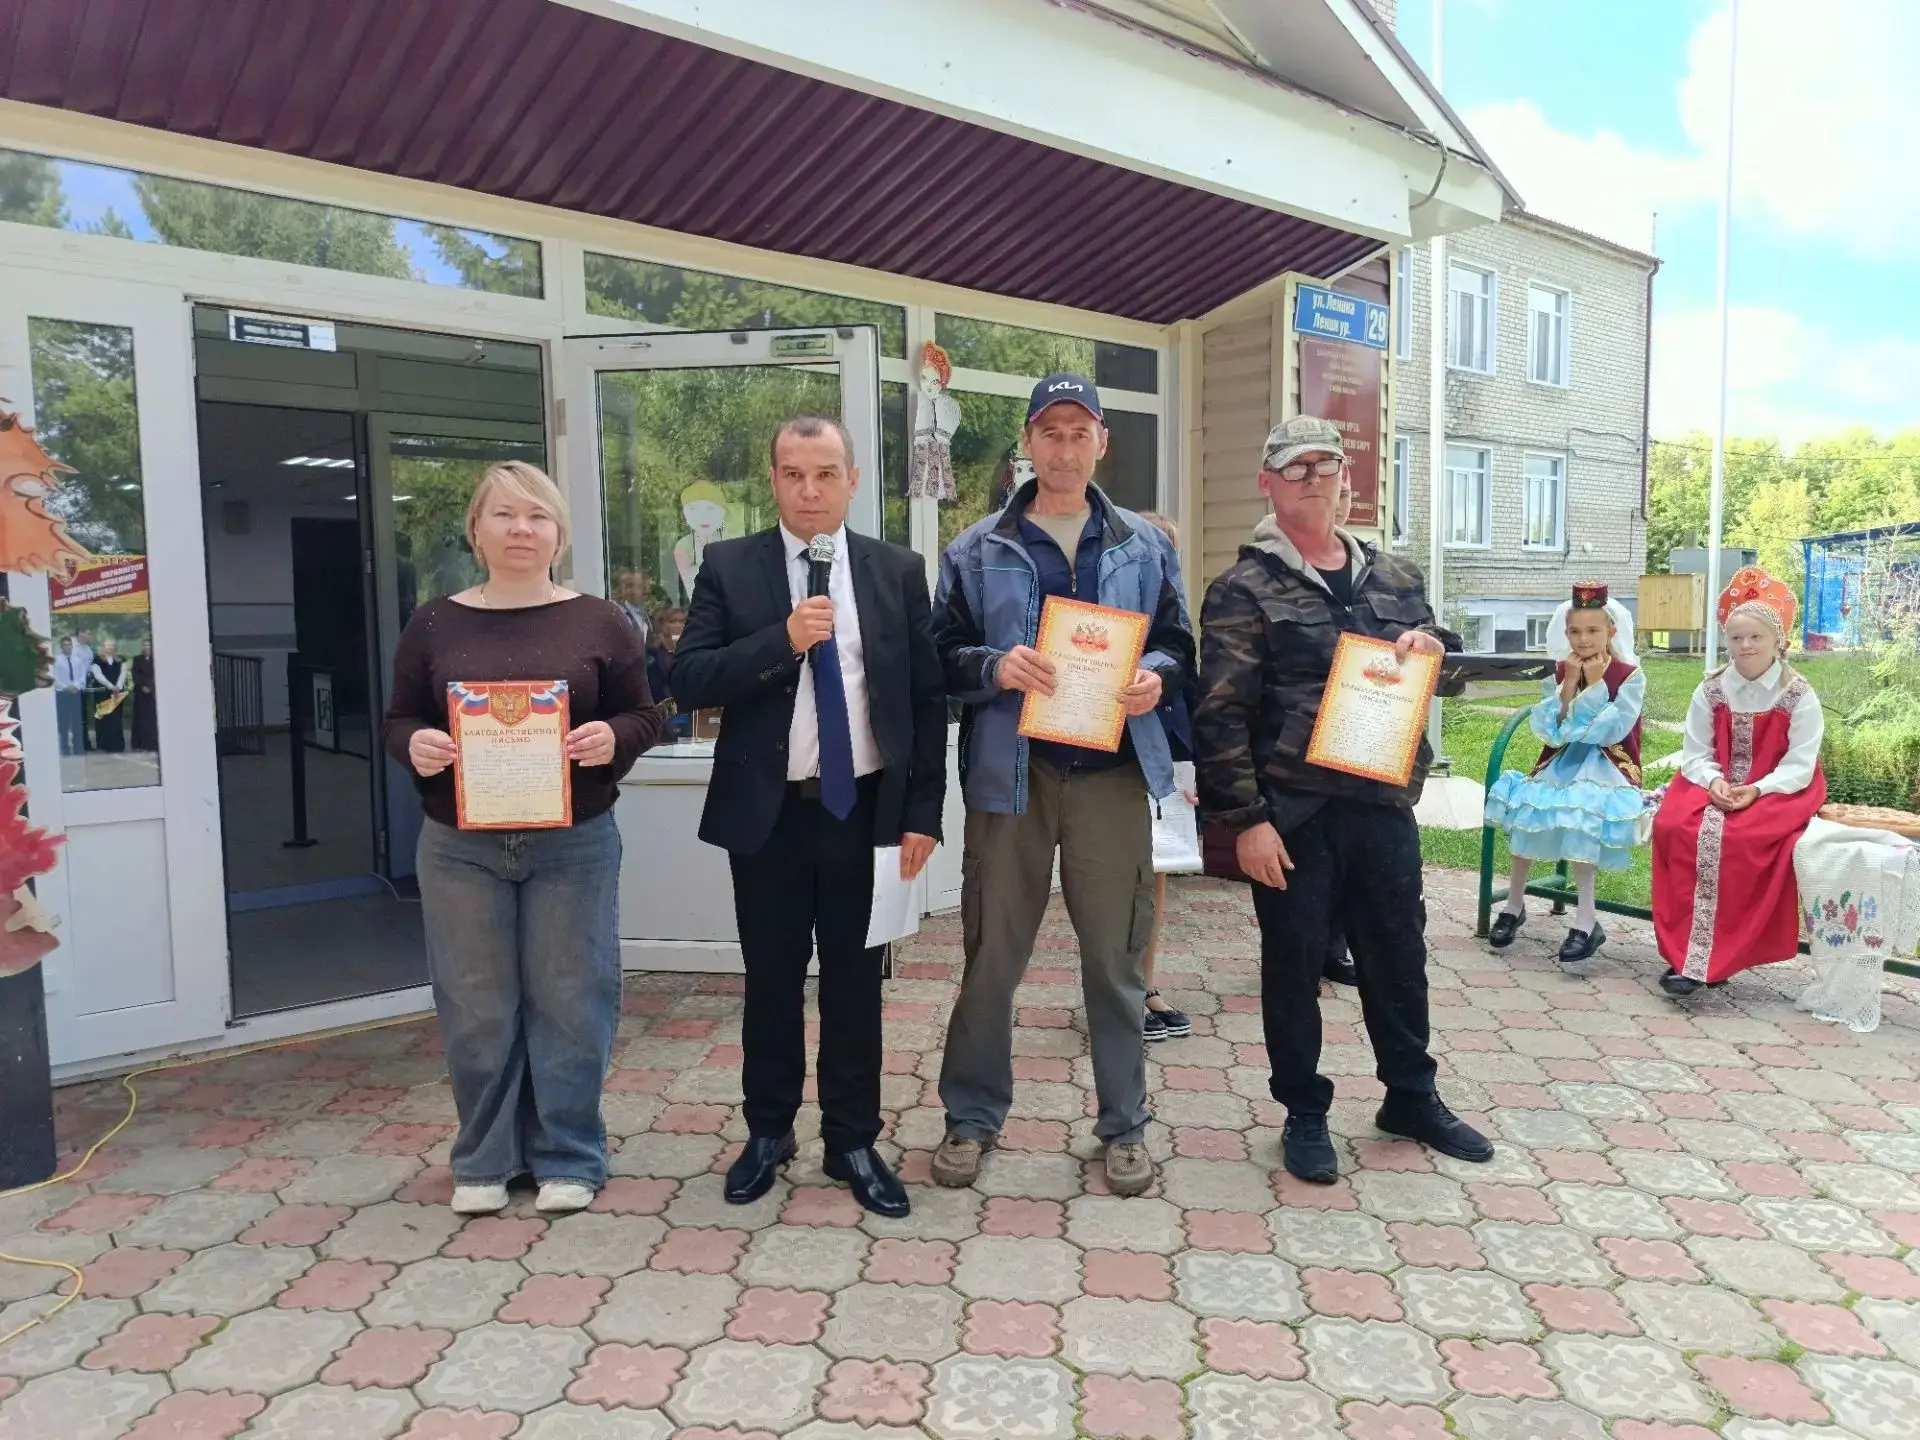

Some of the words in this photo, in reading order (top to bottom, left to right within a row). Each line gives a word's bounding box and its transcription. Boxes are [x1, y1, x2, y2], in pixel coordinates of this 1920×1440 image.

[1312, 293, 1325, 309] ул.
[1326, 294, 1356, 316] Ленина
[1312, 312, 1339, 332] Ленин
[1339, 321, 1351, 337] ур.
[1367, 308, 1387, 342] 29
[464, 728, 558, 736] БЛАГОДАРСТВЕННОЕ
